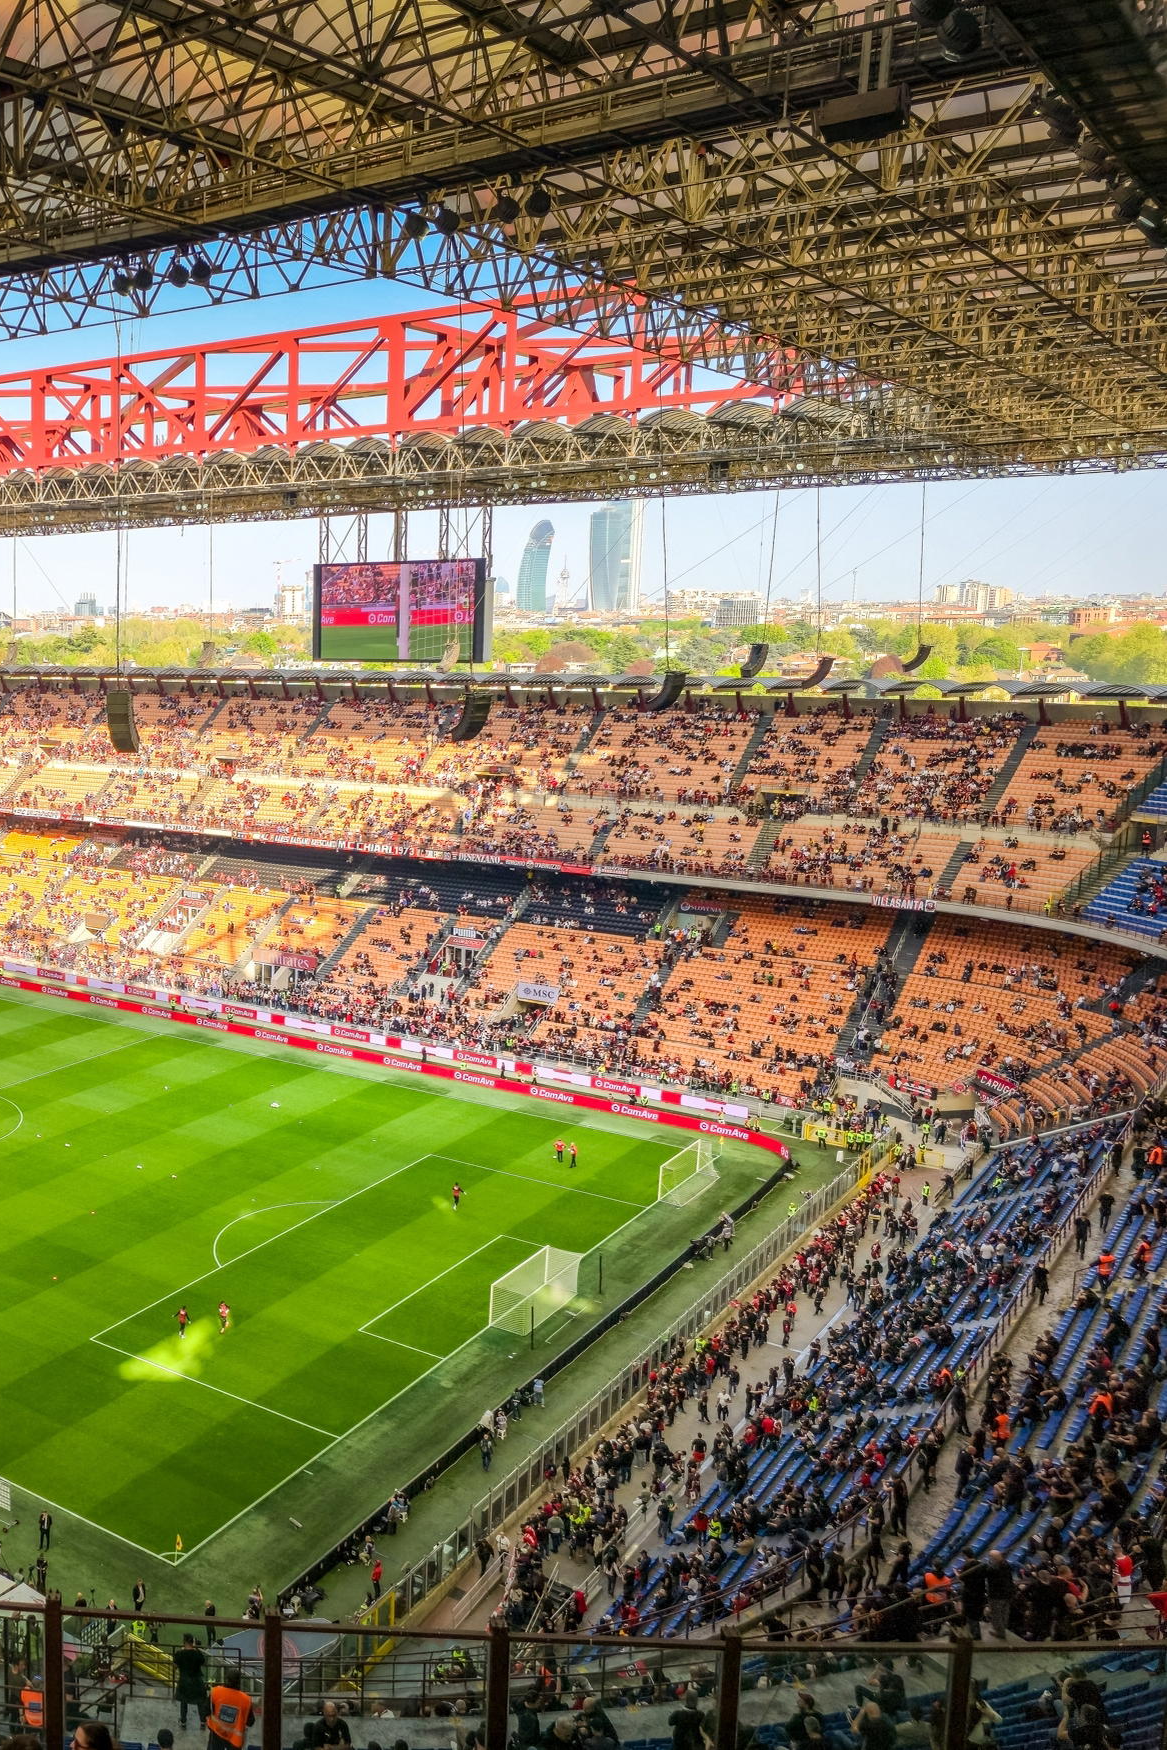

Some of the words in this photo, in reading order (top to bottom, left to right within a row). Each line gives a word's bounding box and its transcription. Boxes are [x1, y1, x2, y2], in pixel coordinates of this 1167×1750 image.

[356, 842, 393, 855] CHIARI
[394, 846, 414, 856] 1973
[458, 852, 501, 864] DESENZANO
[872, 895, 924, 910] VILLASANTA
[1, 977, 21, 987] ComAve
[46, 986, 69, 997] ComAve
[133, 988, 153, 998] ComAve
[533, 988, 555, 998] MSC
[96, 997, 118, 1008] ComAve
[148, 1007, 172, 1018] ComAve
[231, 1007, 253, 1018] ComAve
[203, 1019, 228, 1030] ComAve
[261, 1032, 289, 1043] ComAve
[341, 1029, 366, 1041] ComAve
[325, 1045, 353, 1057] ComAve
[391, 1058, 422, 1071] ComAve
[464, 1053, 492, 1065] ComAve
[462, 1072, 495, 1087] ComAve
[538, 1088, 574, 1103] ComAve
[621, 1105, 659, 1121] ComAve
[709, 1122, 750, 1140] ComAve
